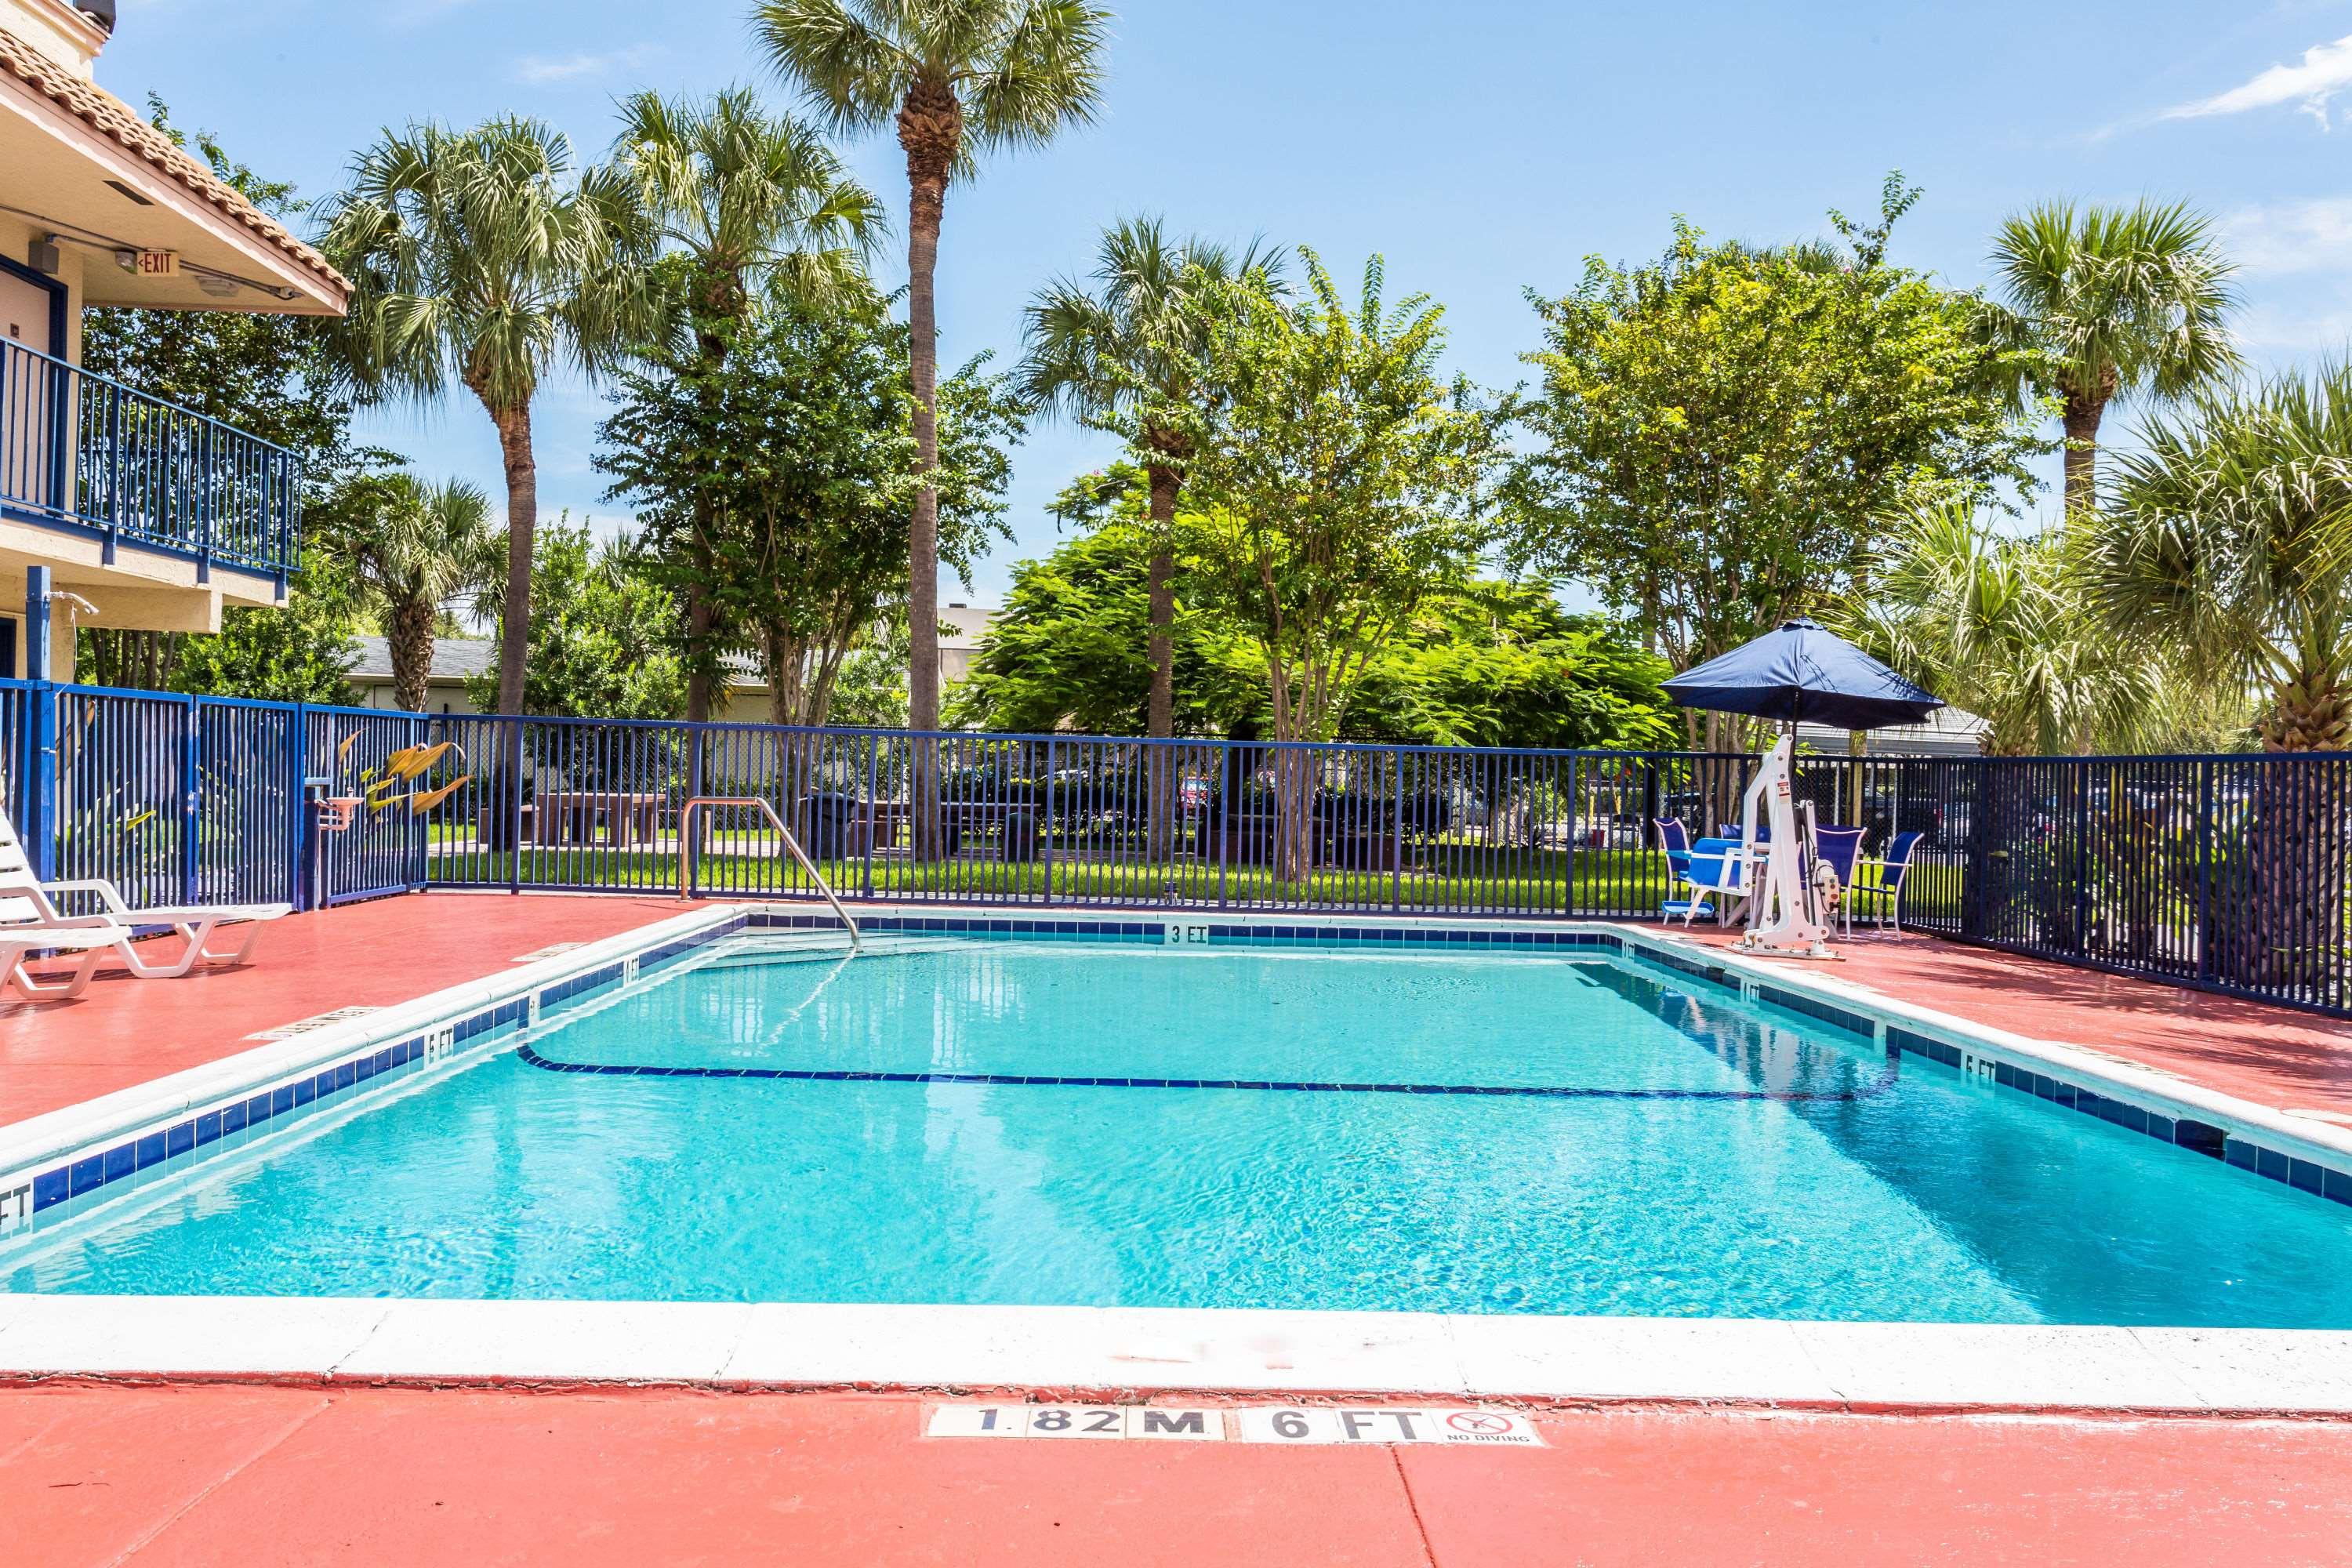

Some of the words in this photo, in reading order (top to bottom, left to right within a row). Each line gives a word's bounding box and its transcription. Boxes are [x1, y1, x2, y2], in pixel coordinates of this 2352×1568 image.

[144, 252, 171, 273] EXIT
[978, 1408, 1120, 1433] 1.82
[1143, 1410, 1205, 1434] M
[1272, 1410, 1310, 1439] 6
[1341, 1410, 1422, 1440] FT
[1475, 1434, 1530, 1443] DIVING
